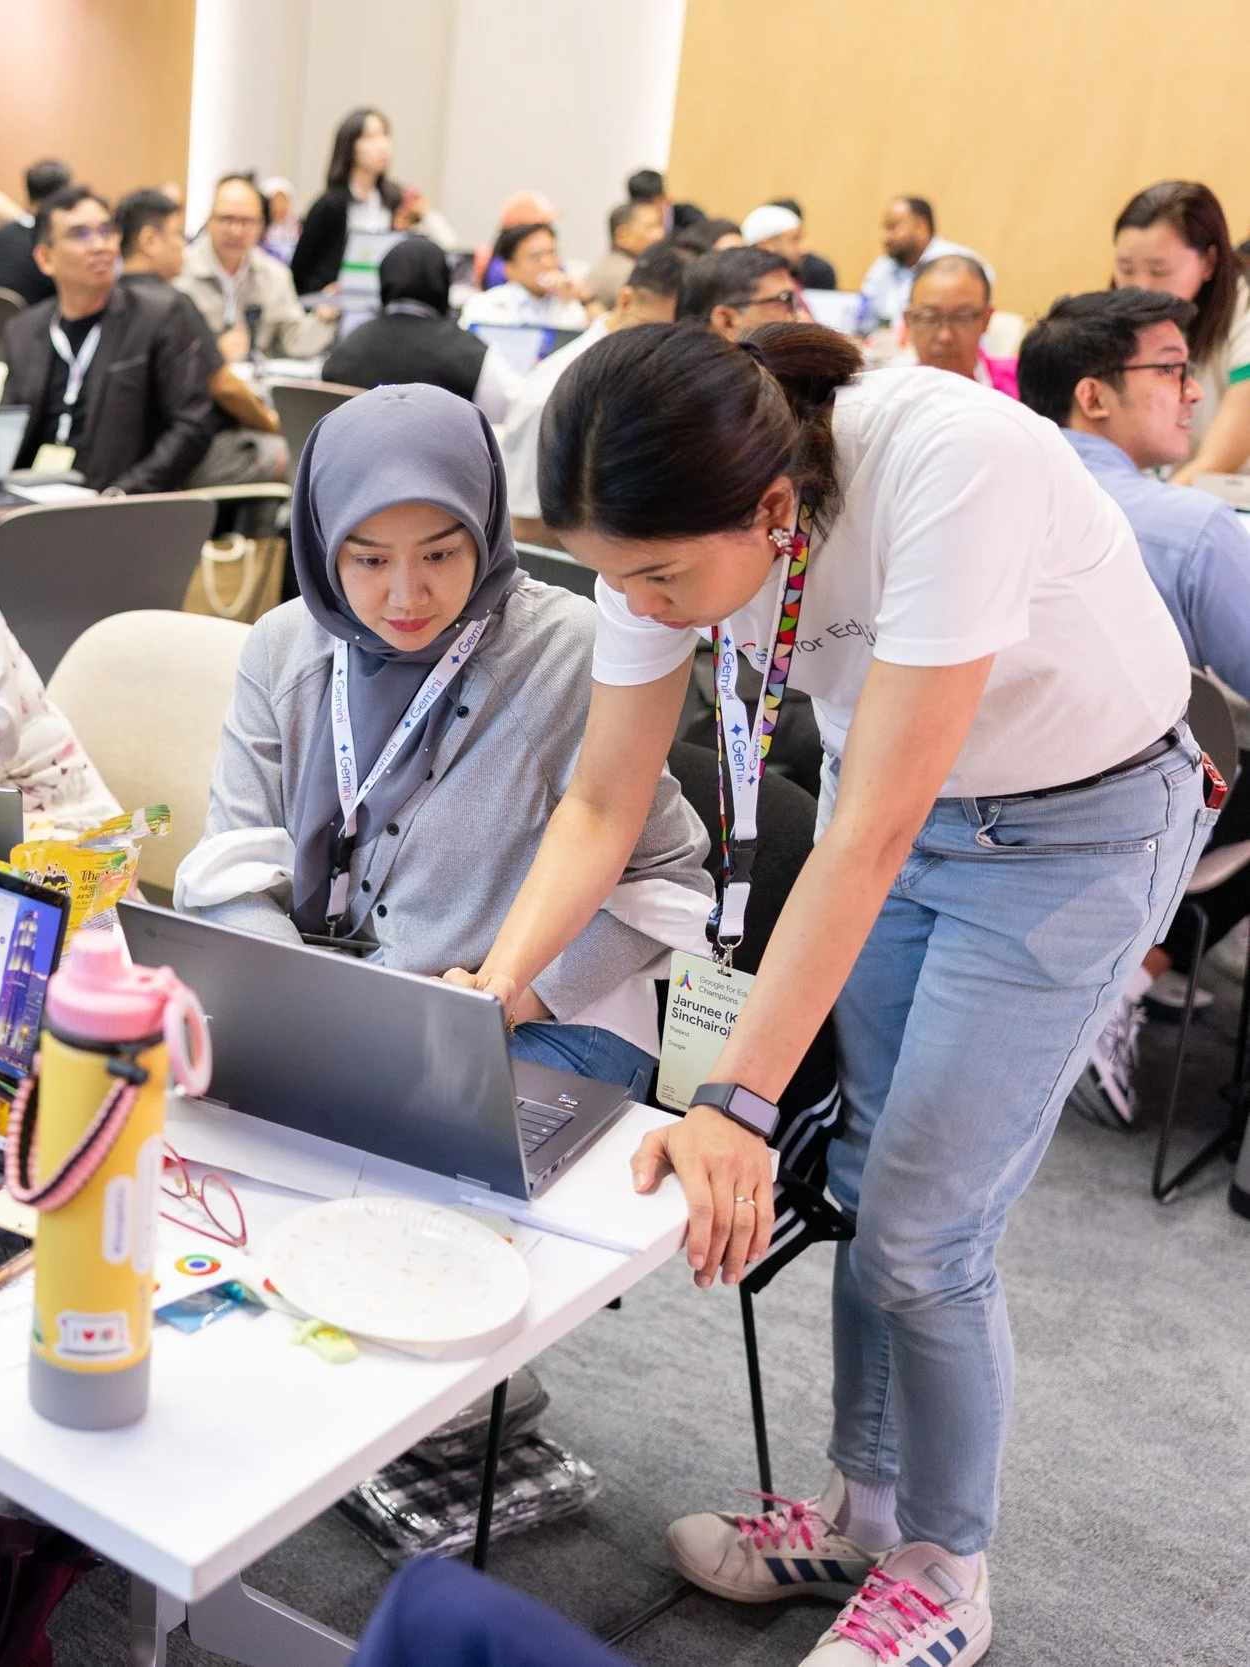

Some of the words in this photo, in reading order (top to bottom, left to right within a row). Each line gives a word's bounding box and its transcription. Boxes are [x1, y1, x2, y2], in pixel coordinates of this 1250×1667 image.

[721, 651, 736, 700] Gemini
[334, 680, 347, 724] Gemini
[410, 677, 444, 719] Gemini
[371, 741, 399, 782] Gemini
[339, 756, 354, 801] Gemini
[698, 985, 739, 1005] Champions
[699, 975, 725, 990] Google
[726, 985, 737, 994] for
[671, 1006, 731, 1039] Sinchairoj
[673, 994, 722, 1019] Jarunee
[667, 1039, 687, 1051] Google
[669, 1025, 690, 1038] Thailand
